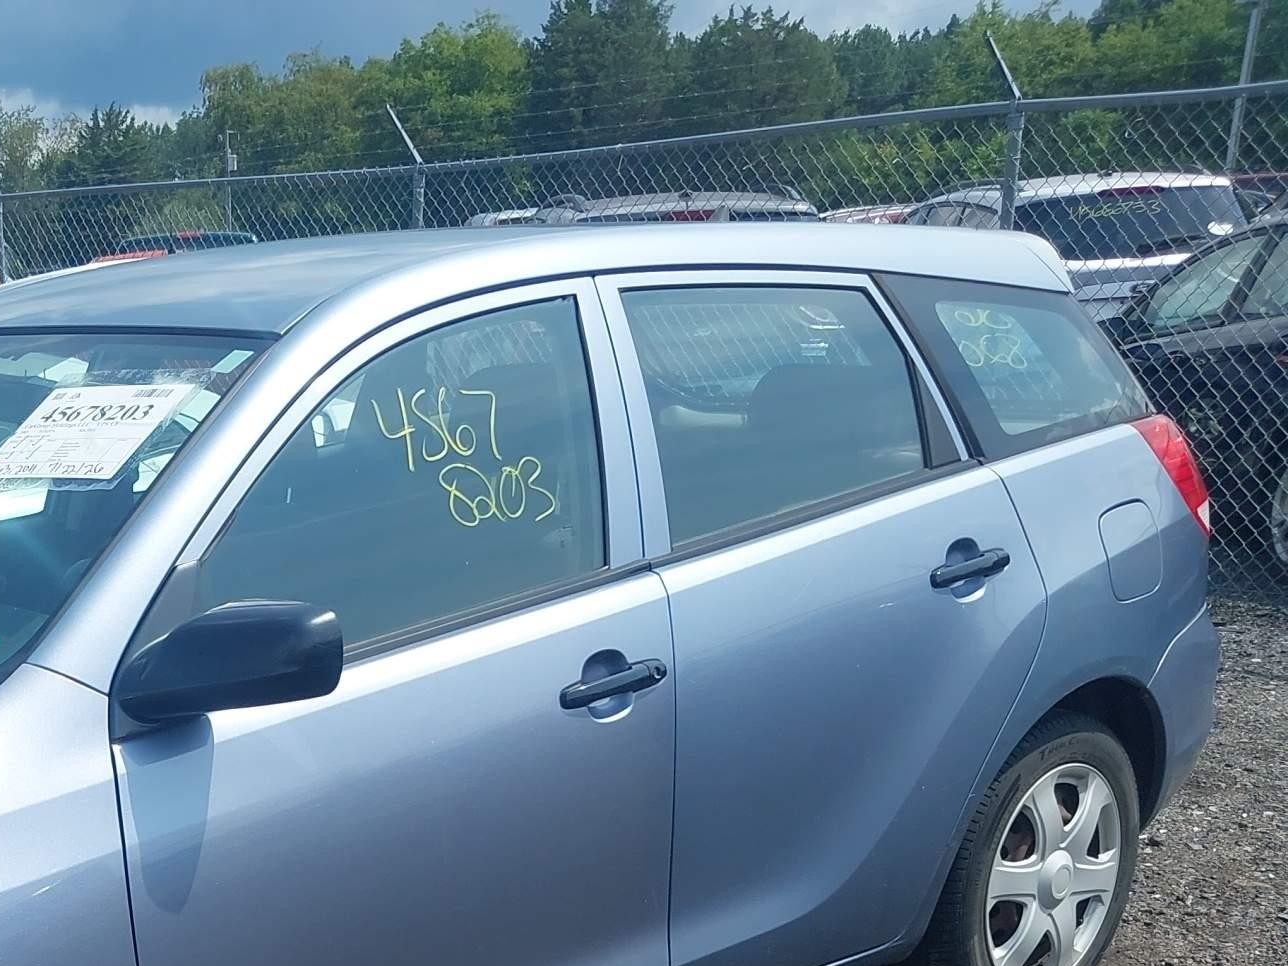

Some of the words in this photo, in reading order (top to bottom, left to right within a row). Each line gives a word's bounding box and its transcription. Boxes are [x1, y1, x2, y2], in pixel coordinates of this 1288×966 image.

[40, 404, 155, 422] 45678203
[370, 386, 503, 473] 4567
[438, 456, 557, 528] 8203
